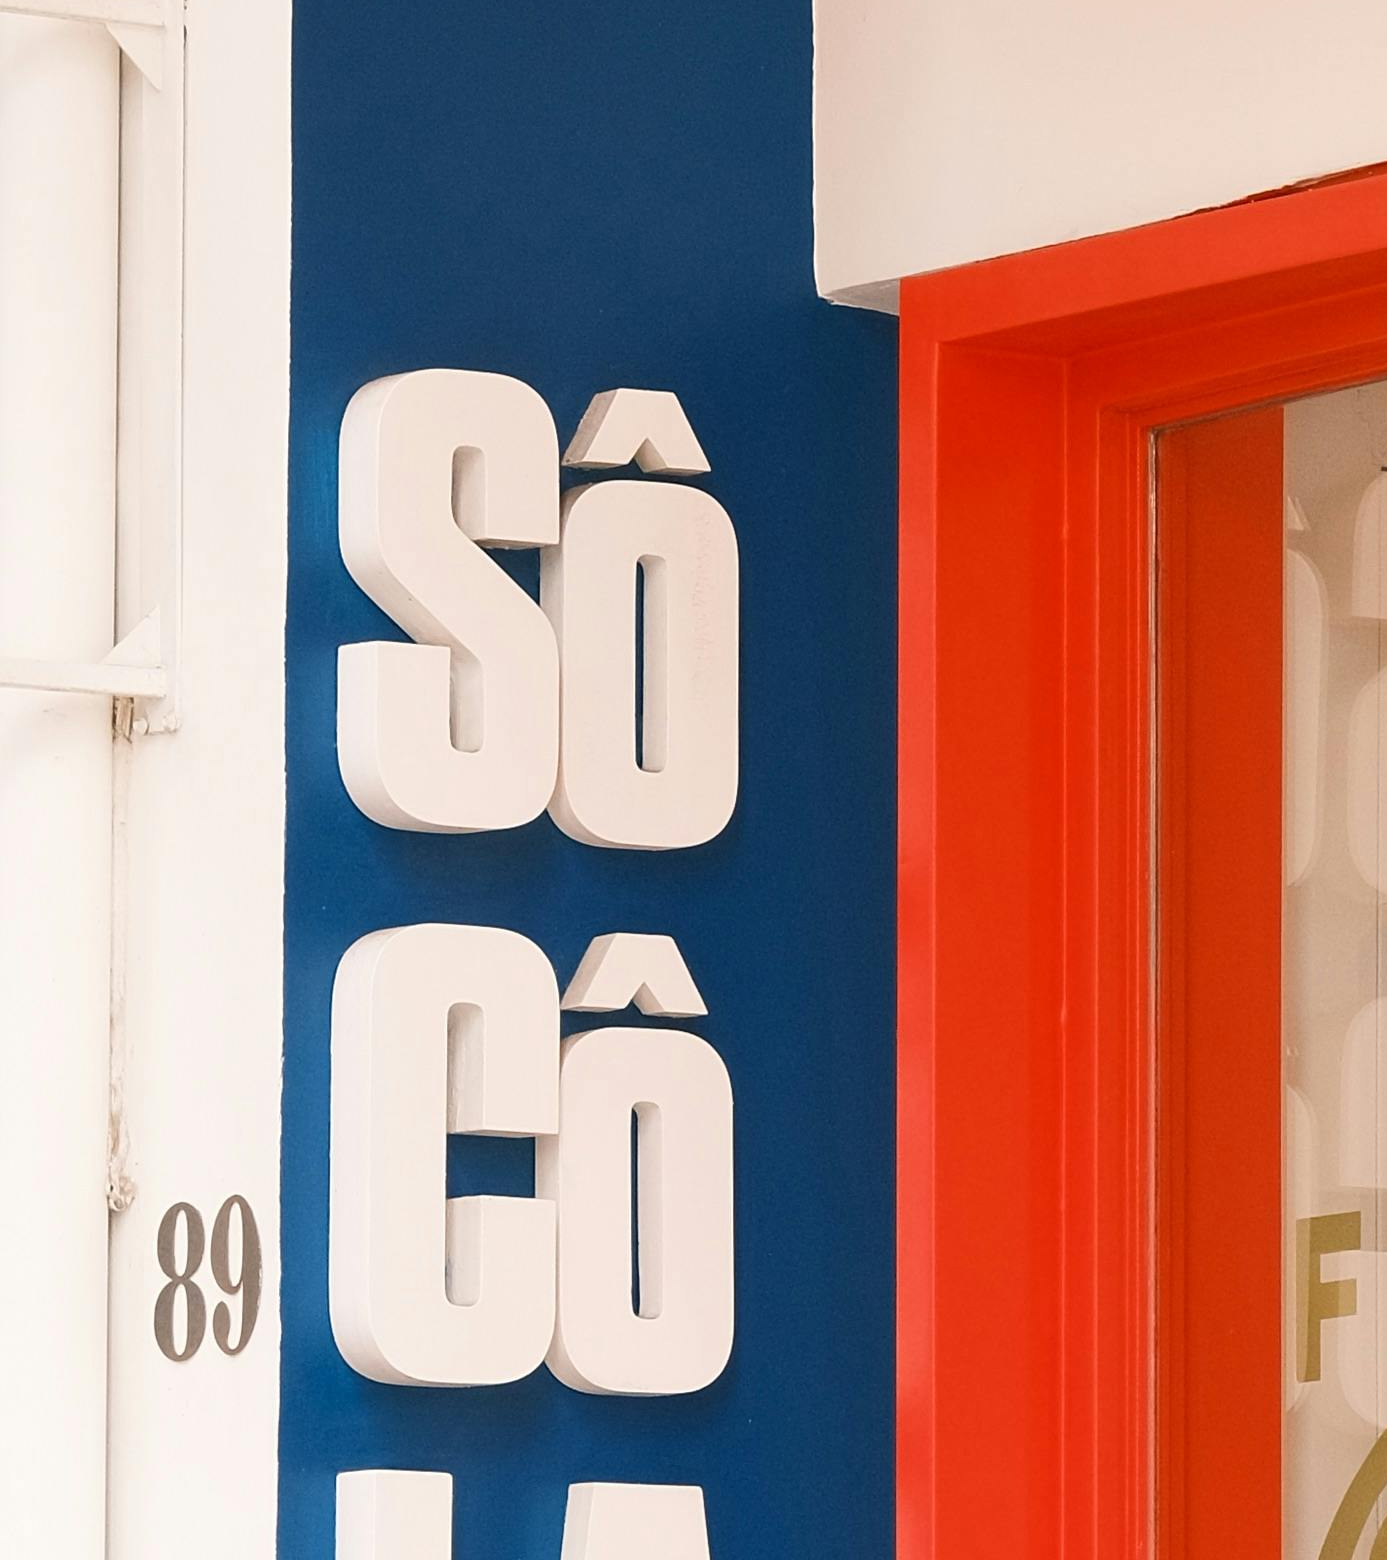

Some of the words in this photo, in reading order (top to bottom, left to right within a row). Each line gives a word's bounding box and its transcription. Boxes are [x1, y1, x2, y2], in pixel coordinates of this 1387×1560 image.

[337, 368, 739, 851] SÔ
[153, 1194, 262, 1362] 89
[330, 923, 734, 1395] CÔ
